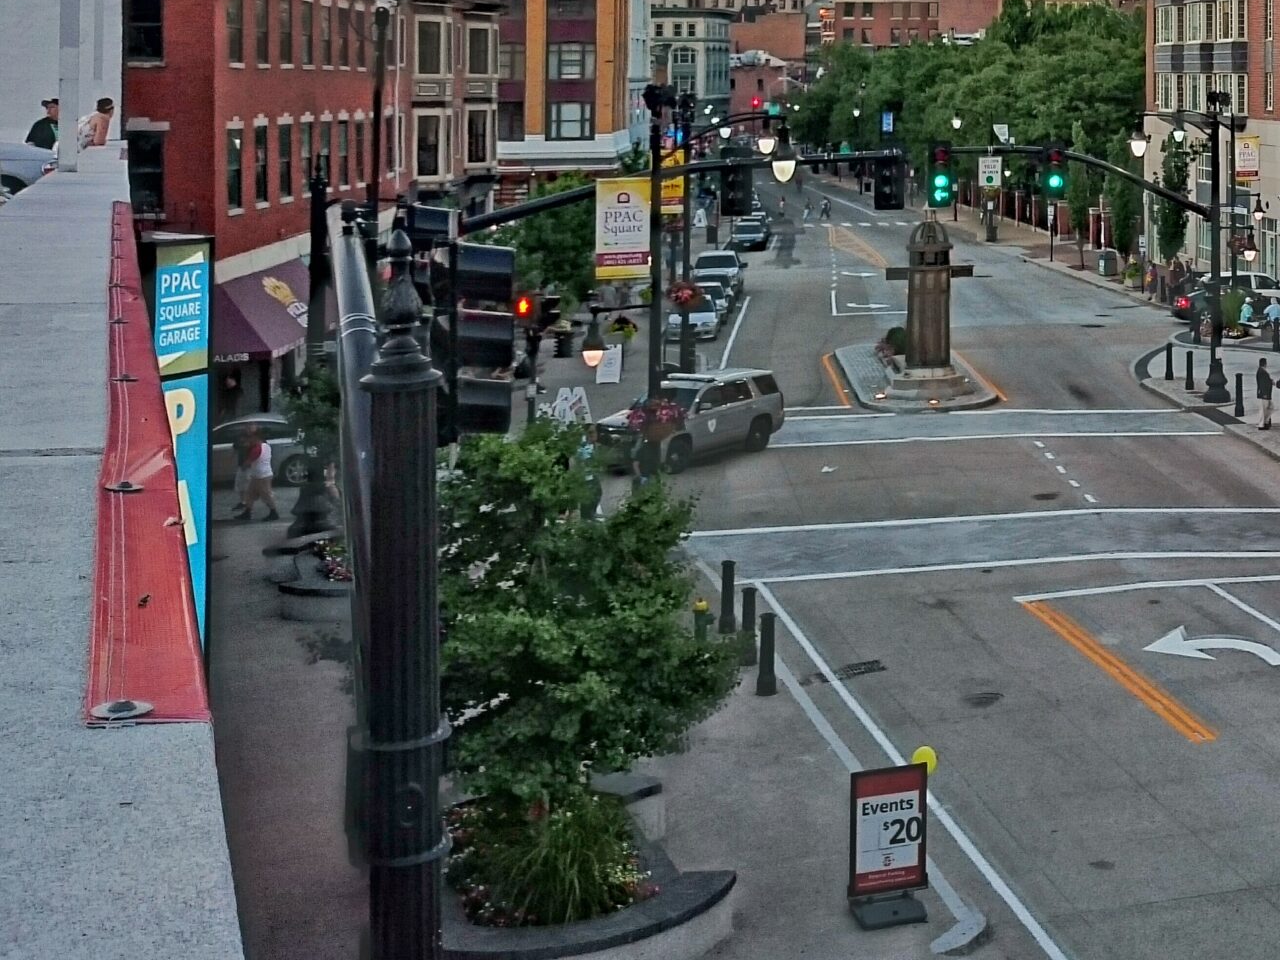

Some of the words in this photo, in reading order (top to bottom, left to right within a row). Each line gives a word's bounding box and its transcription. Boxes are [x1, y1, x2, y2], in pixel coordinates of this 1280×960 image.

[603, 210, 644, 223] PPAC
[603, 223, 643, 237] Square
[161, 270, 202, 295] PPAC
[160, 302, 200, 321] SQUARE
[159, 326, 200, 347] GARAGE
[861, 797, 914, 817] Events
[882, 816, 922, 846] $20
